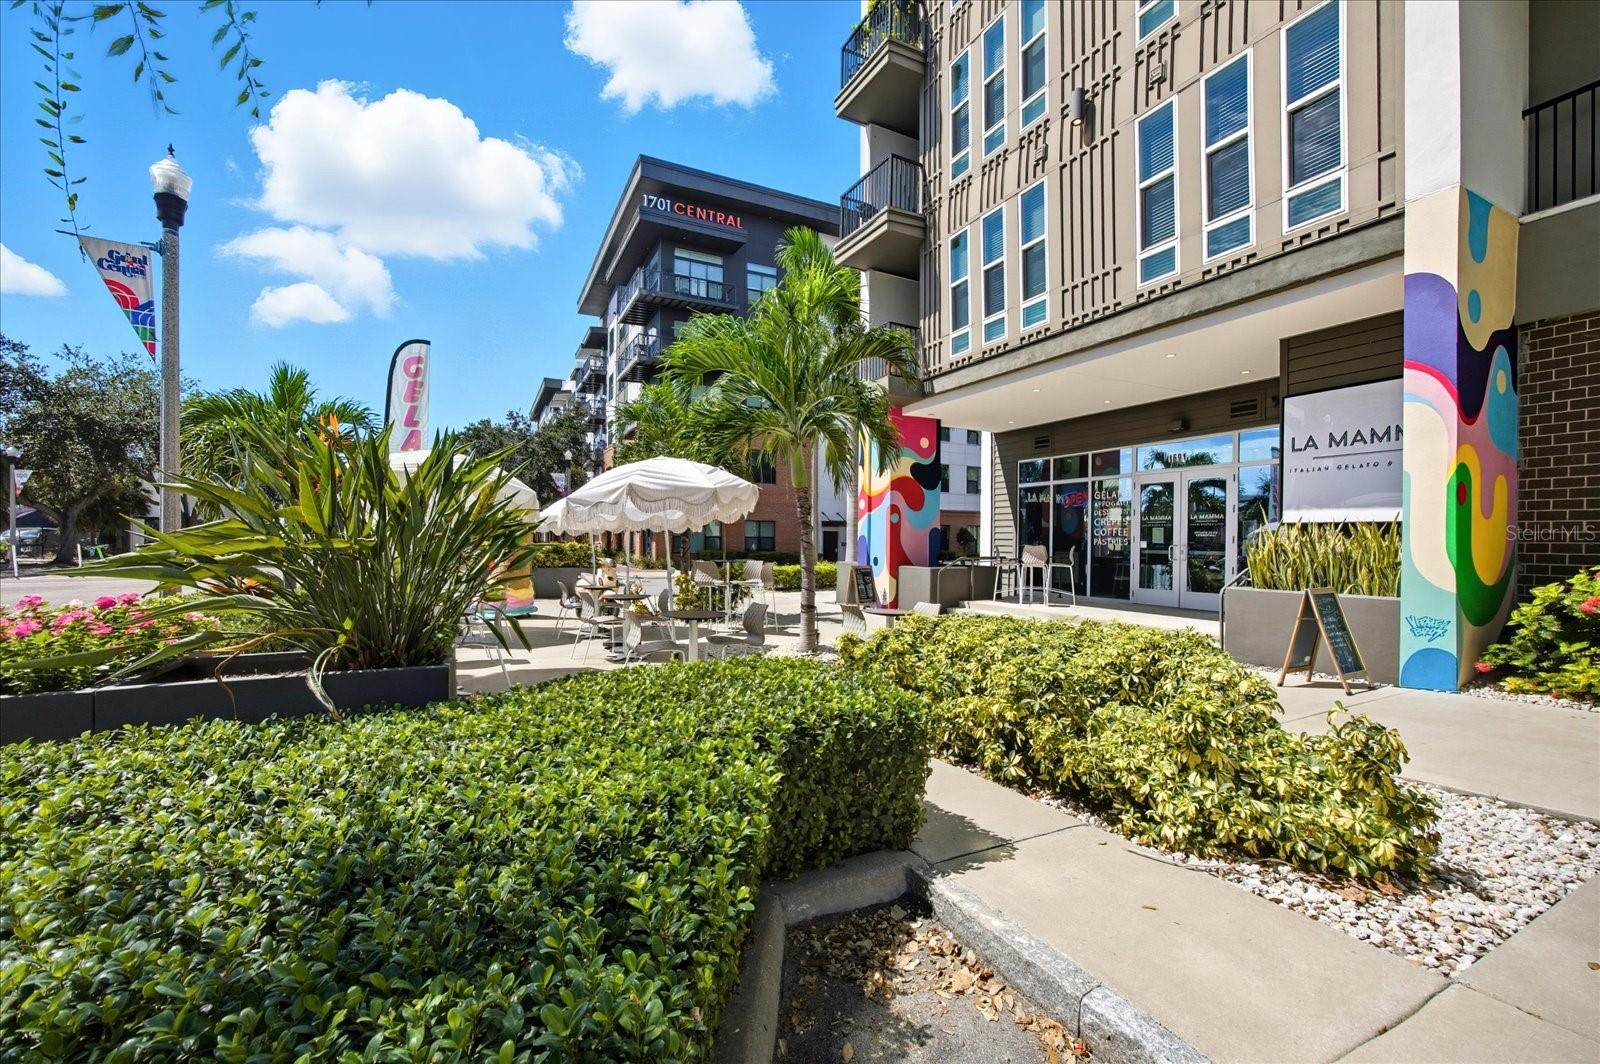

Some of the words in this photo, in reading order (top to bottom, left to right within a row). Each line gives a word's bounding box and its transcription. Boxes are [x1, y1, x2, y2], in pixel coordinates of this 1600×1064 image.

[643, 194, 671, 212] 1701
[674, 202, 743, 229] CENTRAL
[1291, 434, 1319, 452] LA
[1336, 461, 1380, 470] GELATO
[1094, 528, 1128, 537] COFFEE
